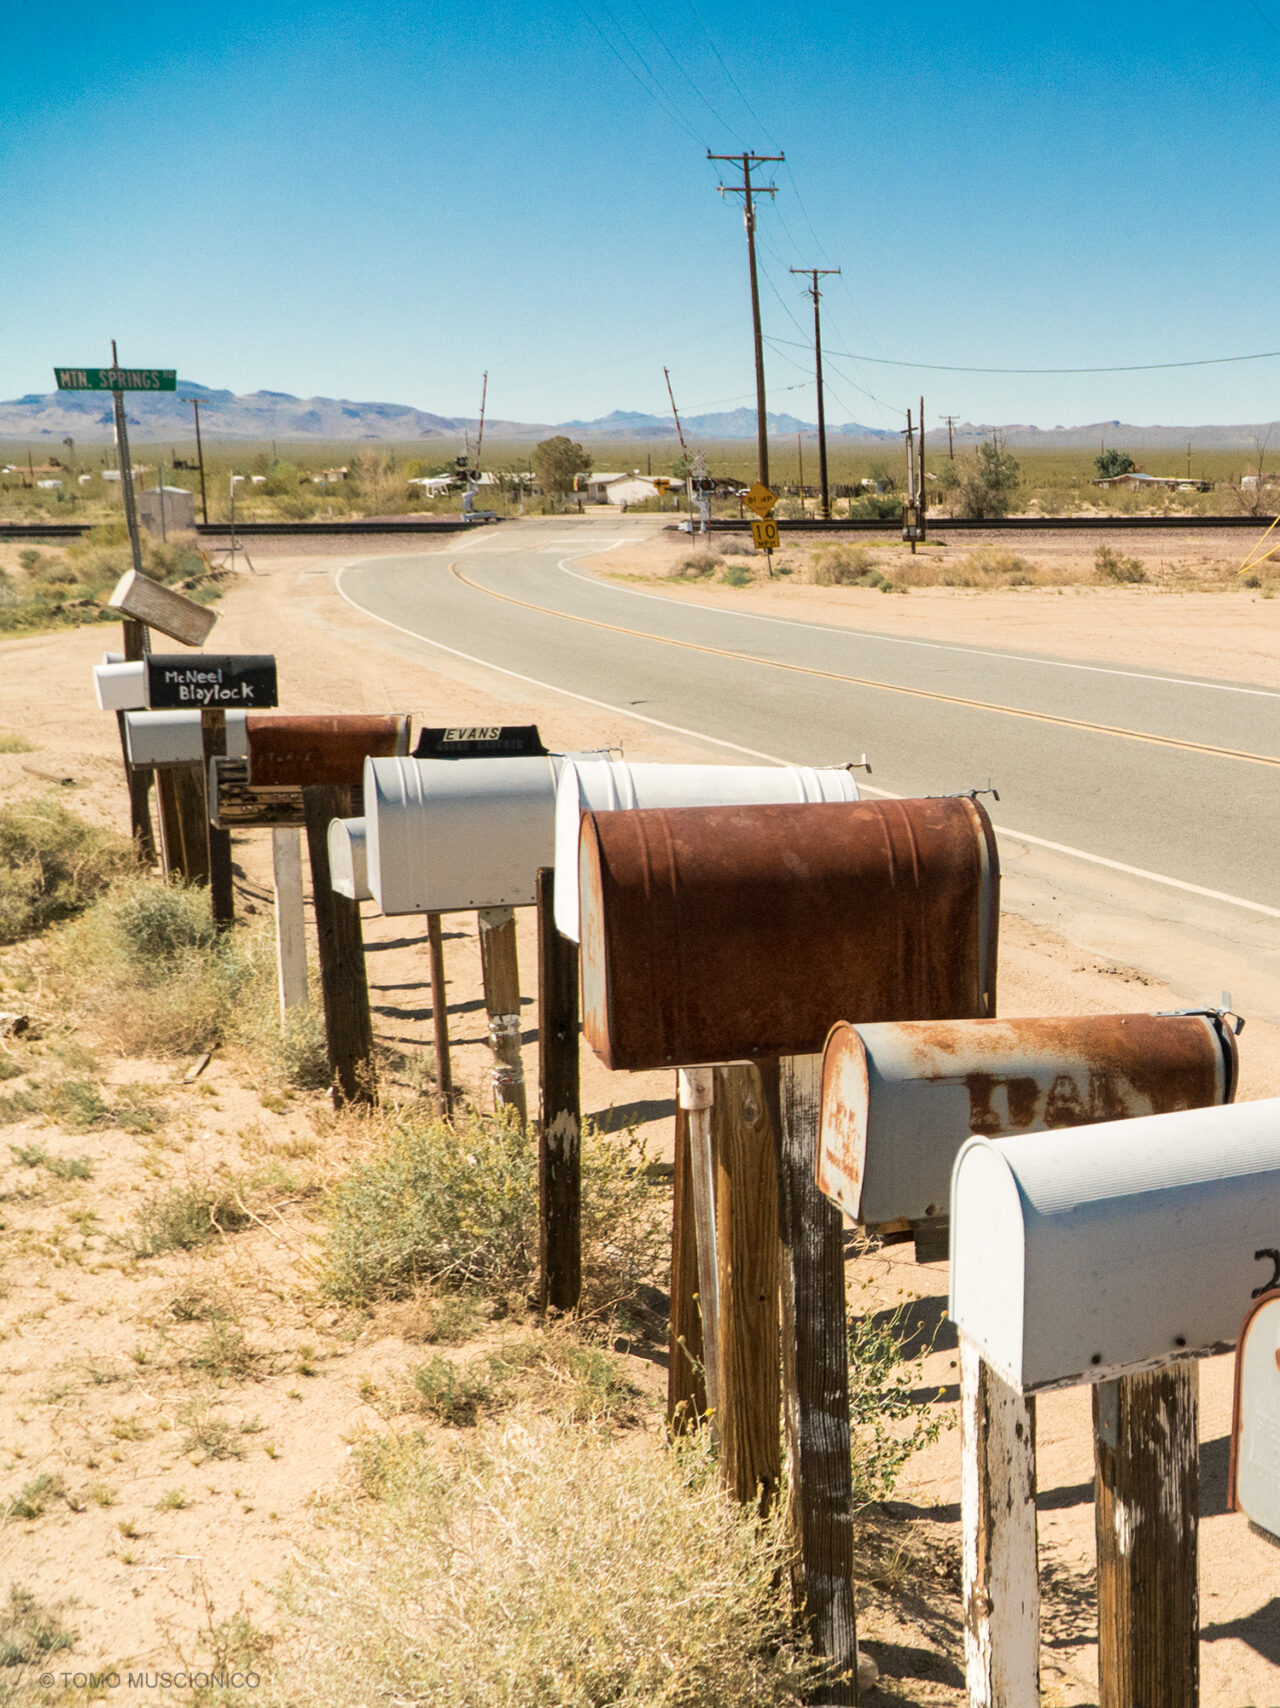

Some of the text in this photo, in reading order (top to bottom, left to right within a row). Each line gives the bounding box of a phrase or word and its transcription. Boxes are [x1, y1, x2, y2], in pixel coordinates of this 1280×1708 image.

[60, 370, 92, 388] MTN.
[99, 370, 160, 389] SPRINGS
[756, 524, 775, 540] 10
[165, 668, 223, 684] McNeel
[179, 681, 255, 705] Blaylock
[445, 728, 499, 741] EVANS
